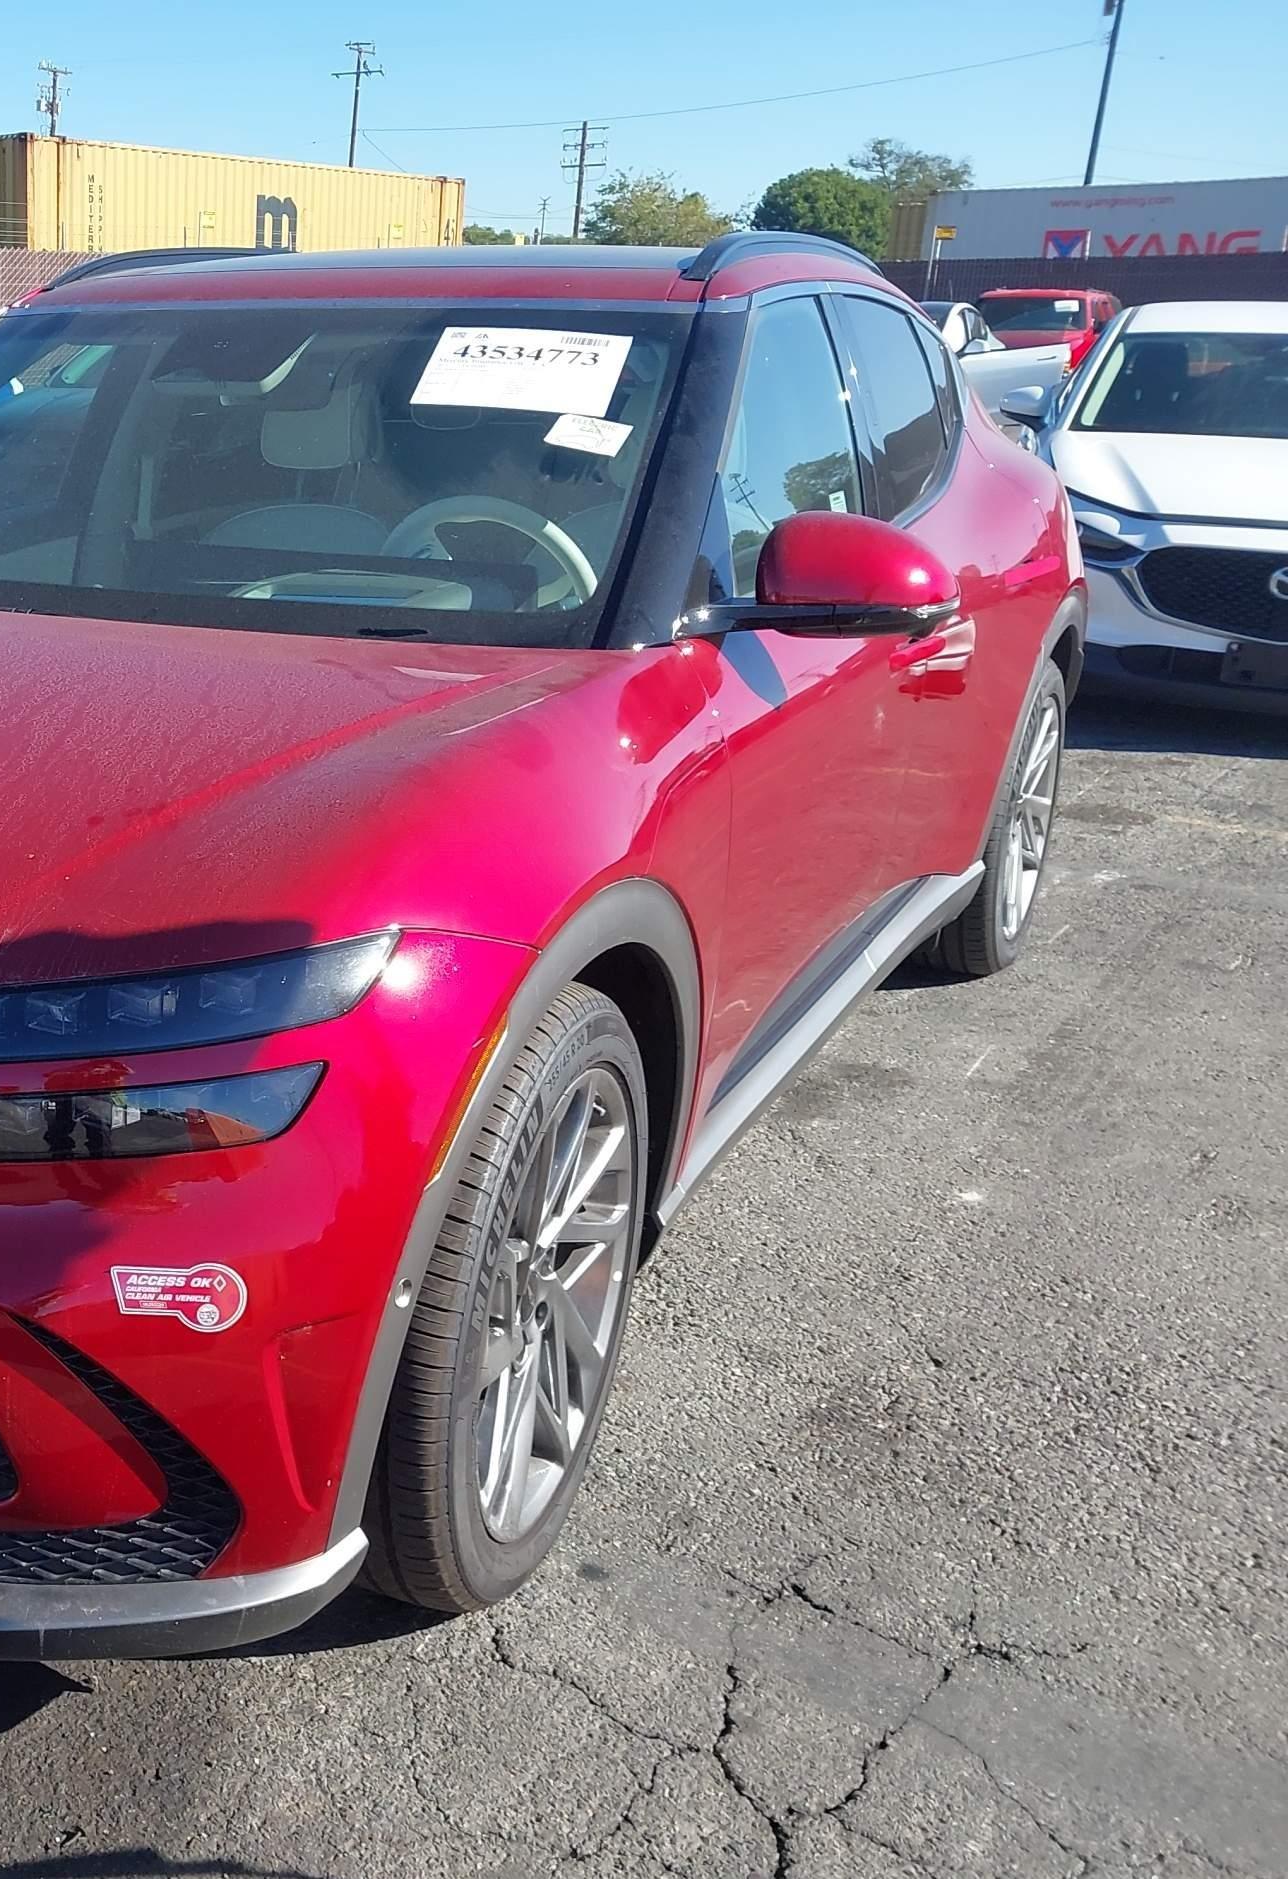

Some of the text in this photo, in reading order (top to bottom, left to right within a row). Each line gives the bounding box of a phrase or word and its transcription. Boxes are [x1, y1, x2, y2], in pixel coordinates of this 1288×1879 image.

[1103, 230, 1262, 257] YANG
[453, 344, 600, 366] 43534773
[471, 1107, 540, 1331] MICHELIN
[126, 1274, 213, 1289] ACCESS OK
[125, 1292, 211, 1303] CLEAN AIR VEHICLE
